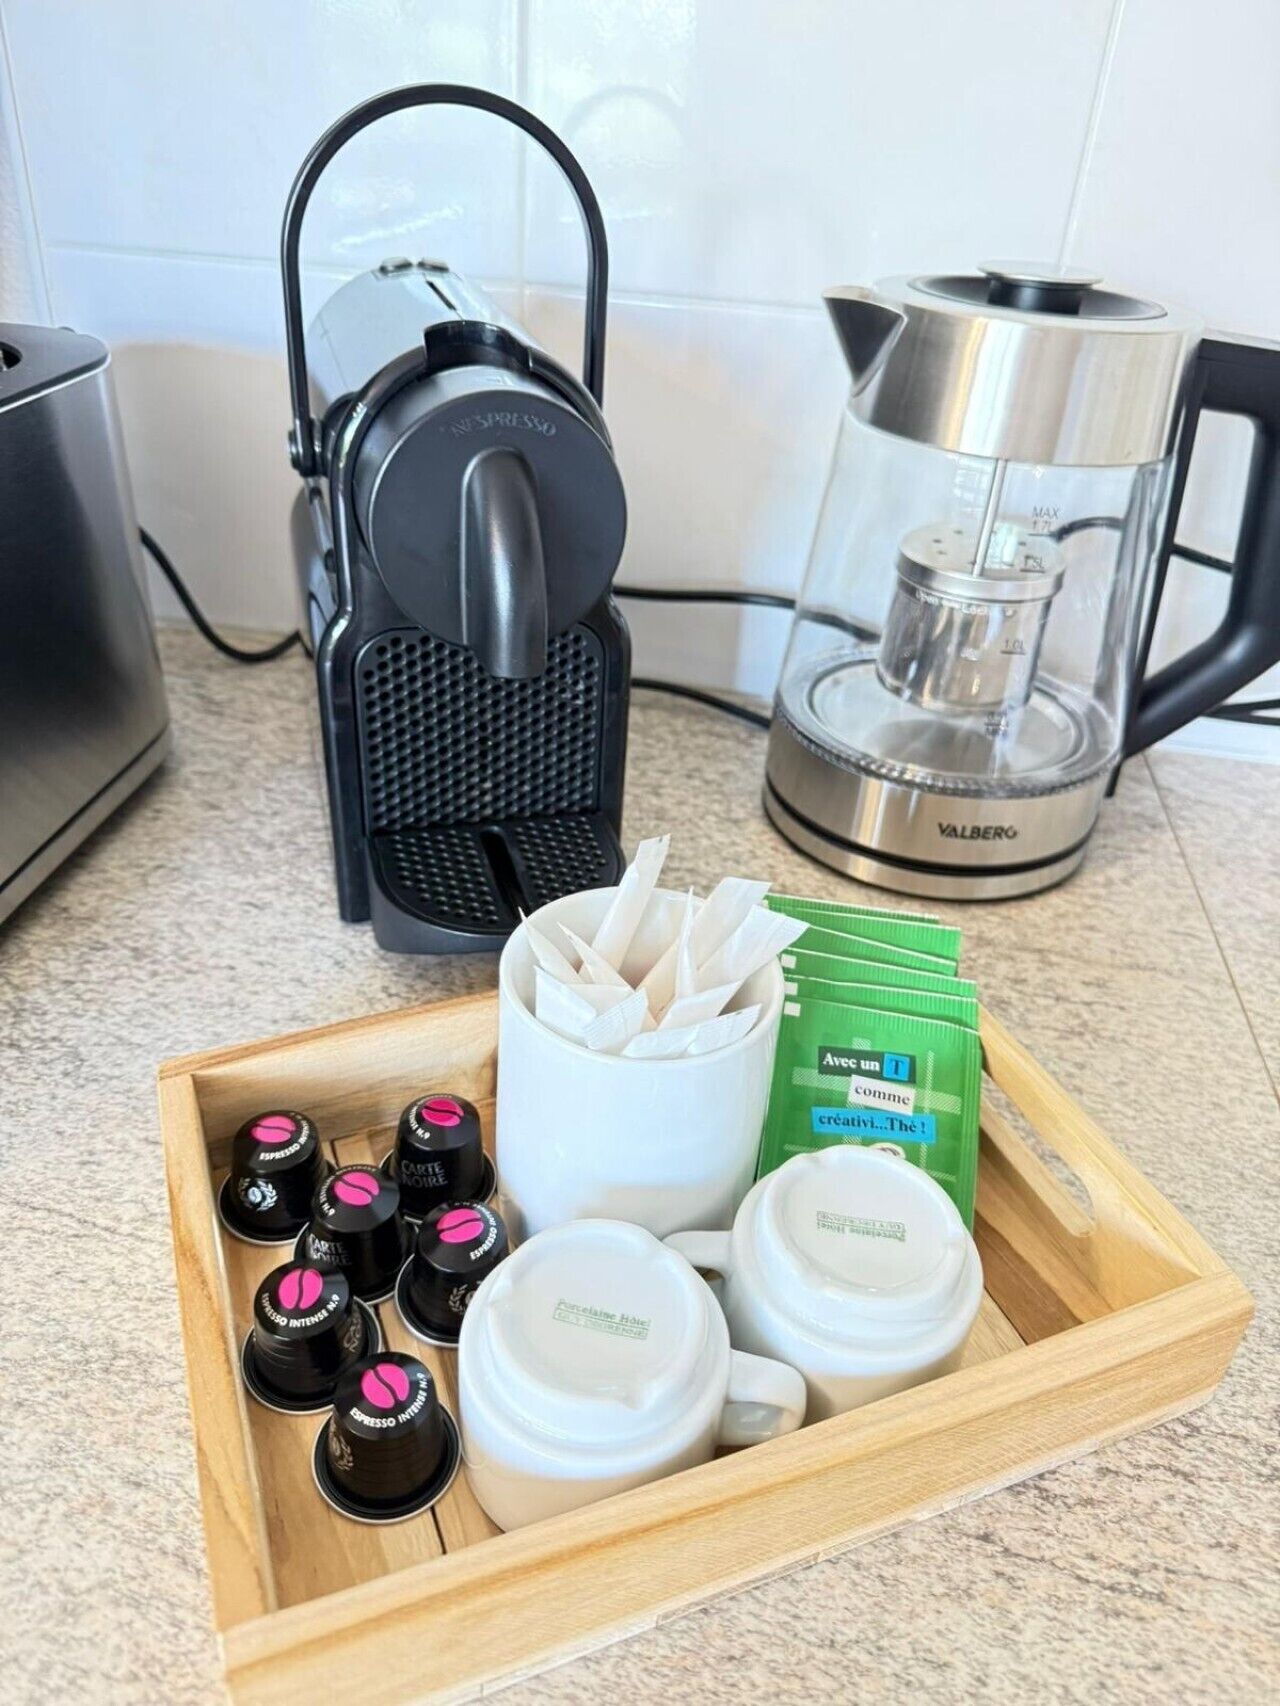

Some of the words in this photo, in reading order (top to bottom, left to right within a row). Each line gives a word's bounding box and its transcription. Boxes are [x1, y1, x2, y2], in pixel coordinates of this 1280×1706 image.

[450, 411, 557, 437] NESPRESSO
[1032, 506, 1060, 519] MAX
[938, 821, 1018, 840] VALBERG
[822, 1052, 857, 1069] Avec
[860, 1059, 880, 1072] un
[888, 1058, 906, 1077] T
[854, 1084, 911, 1106] comme
[259, 1142, 301, 1161] ESPRESSO
[401, 1160, 445, 1176] CARTE
[401, 1173, 449, 1189] NOIRE
[469, 1226, 498, 1261] ESPRESSO
[262, 1292, 288, 1327] ESPRESSO
[289, 1308, 329, 1328] INTENSE
[349, 1406, 396, 1428] ESPRESSO
[397, 1389, 428, 1424] INTENSE
